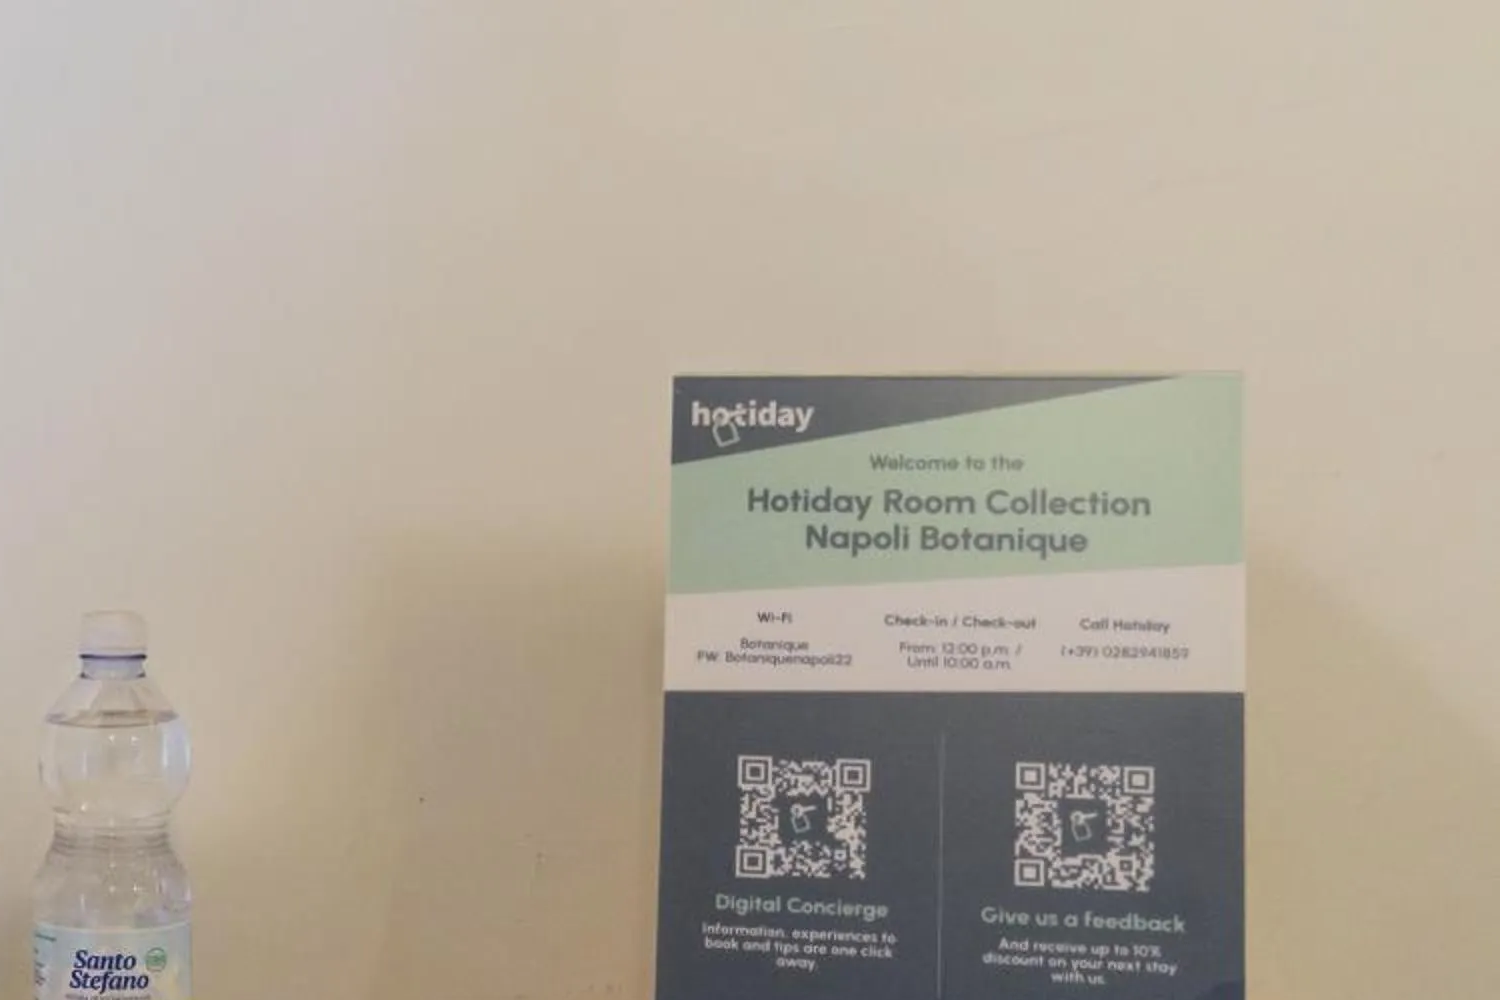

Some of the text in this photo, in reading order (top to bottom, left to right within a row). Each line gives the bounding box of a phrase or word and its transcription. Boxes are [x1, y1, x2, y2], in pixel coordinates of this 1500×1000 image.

[691, 400, 815, 433] hotiday
[869, 453, 1024, 471] Welcome to the
[748, 486, 1152, 521] Hotiday Room Collection
[806, 524, 1088, 560] Napoli Botanique
[884, 614, 948, 627] Check-in
[962, 615, 1037, 629] Check-out
[1079, 618, 1109, 631] Call
[740, 637, 809, 652] Botanique
[907, 656, 939, 668] Until
[715, 893, 889, 922] Digital Concierge
[981, 907, 1186, 933] Give us a feedback
[705, 936, 893, 958] book and tips are one click
[792, 929, 878, 944] experiences
[882, 932, 896, 944] to
[998, 937, 1162, 959] And receive up to 10%
[74, 950, 137, 970] Santo
[982, 951, 1178, 977] discount on your next stay
[69, 970, 149, 994] Stefano
[1050, 971, 1085, 984] with
